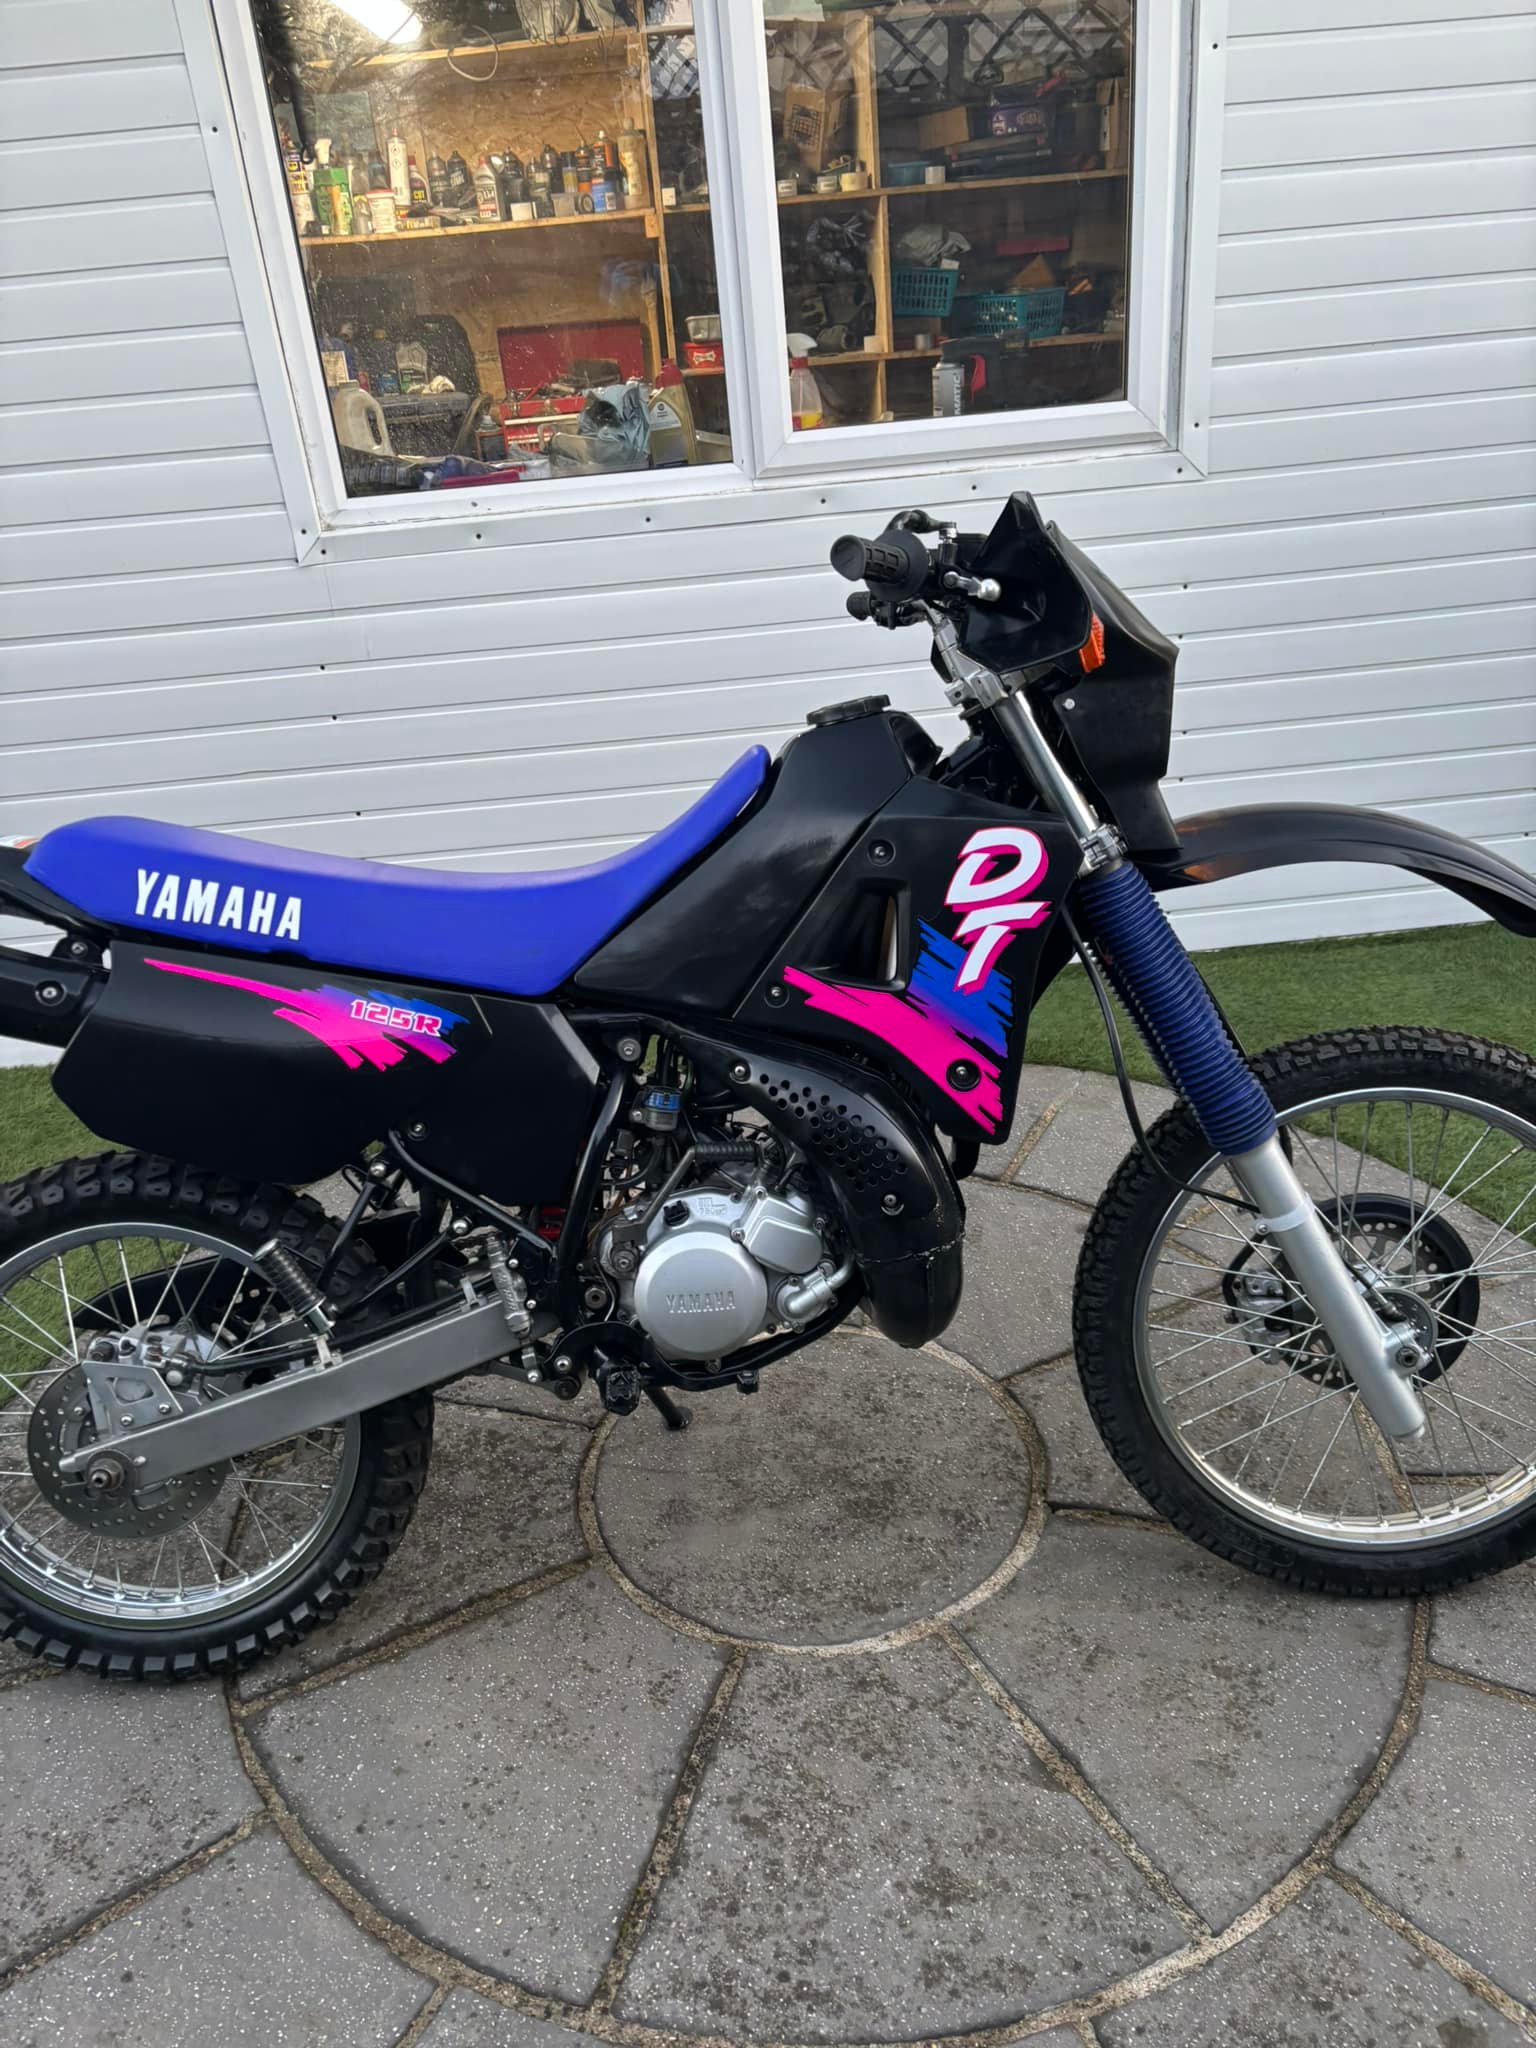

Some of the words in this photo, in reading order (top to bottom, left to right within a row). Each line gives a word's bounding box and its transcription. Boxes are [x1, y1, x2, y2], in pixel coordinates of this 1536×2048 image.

[135, 868, 302, 941] YAMAHA
[944, 826, 1051, 996] DT
[350, 999, 442, 1037] 125R
[665, 1290, 736, 1314] YAMAHA
